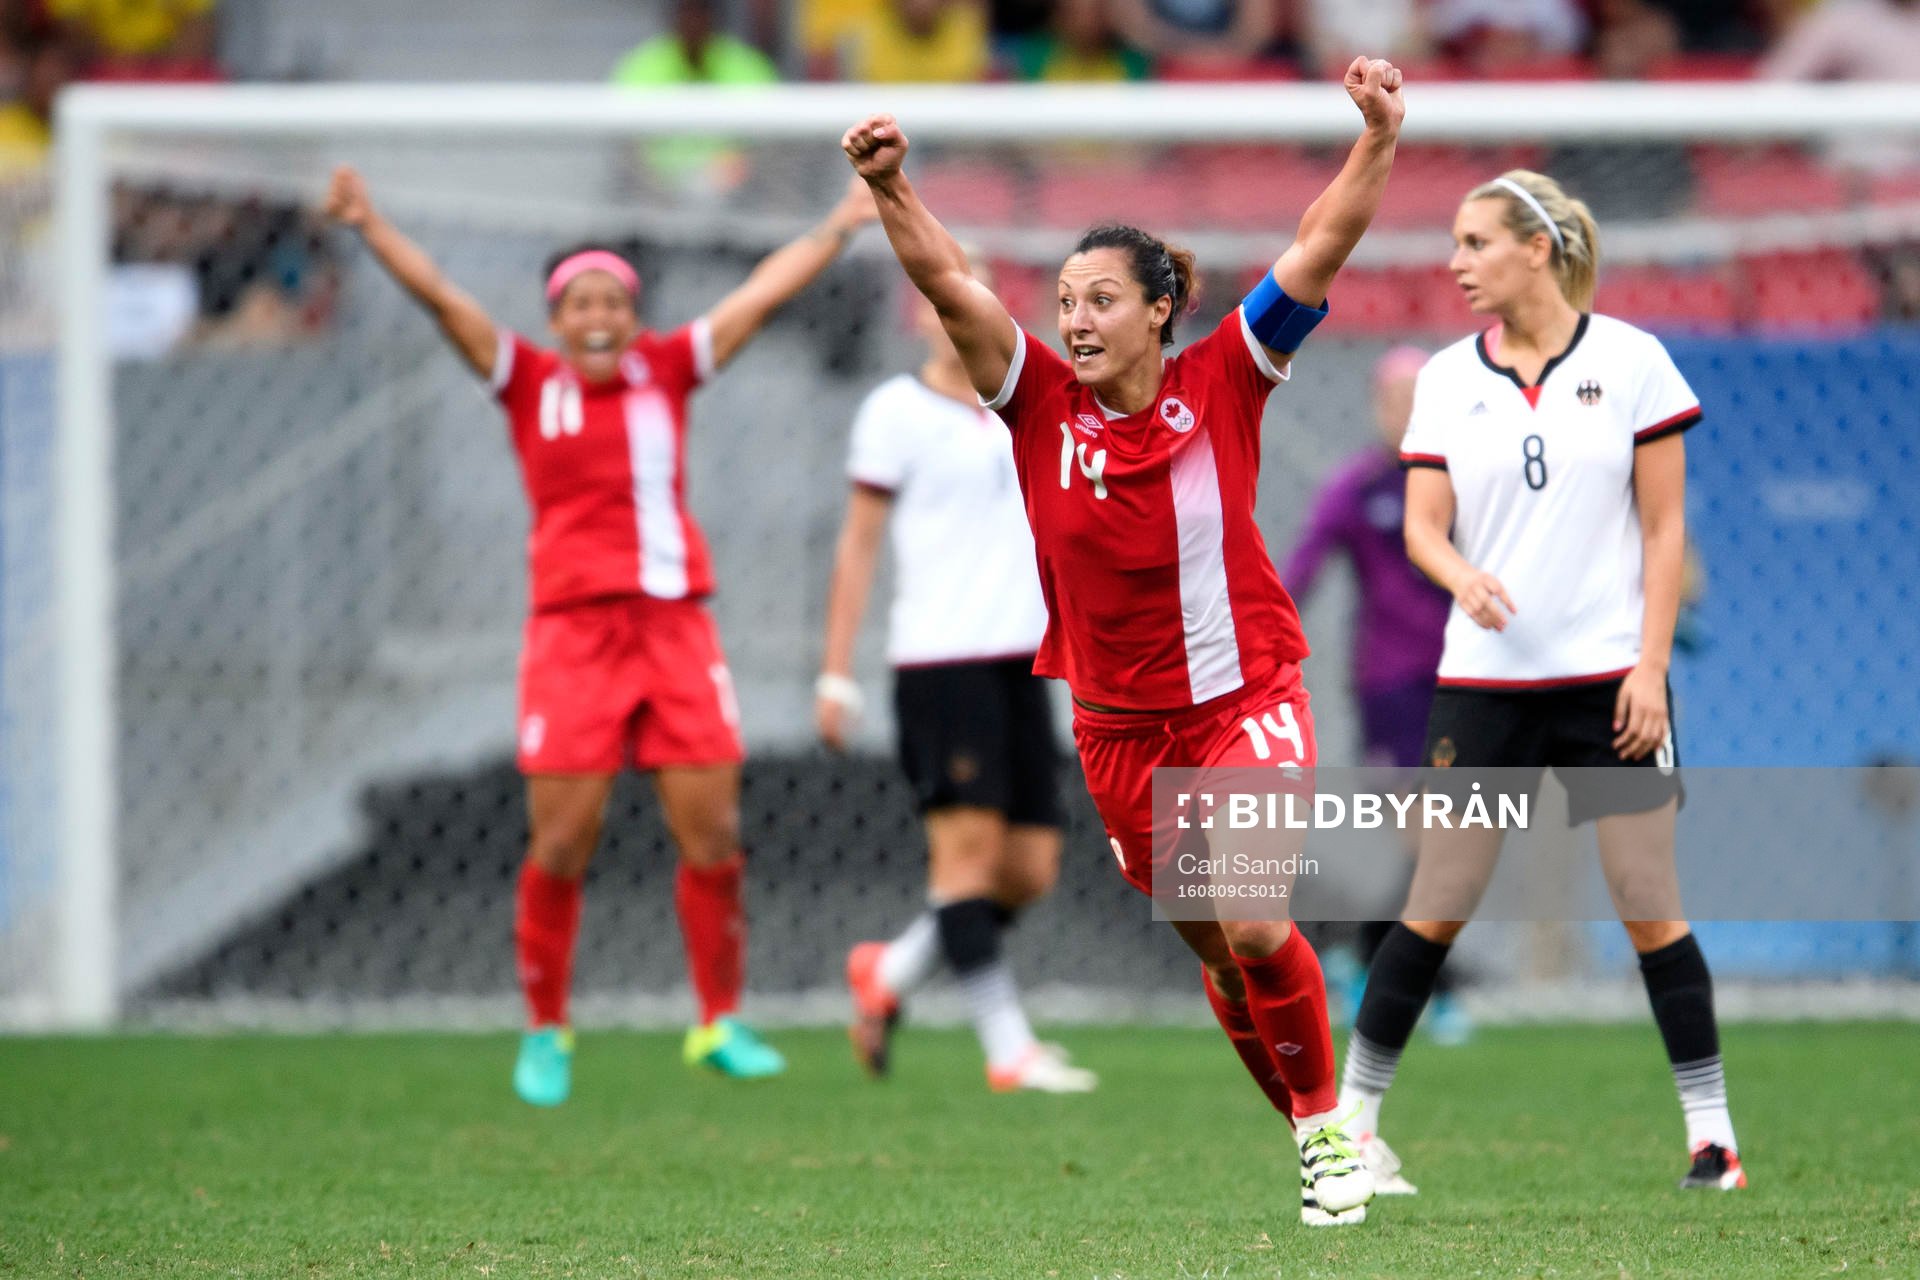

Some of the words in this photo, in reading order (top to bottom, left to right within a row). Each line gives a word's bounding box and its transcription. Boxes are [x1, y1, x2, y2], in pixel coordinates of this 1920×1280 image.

[1074, 422, 1098, 438] umbro
[1060, 421, 1108, 500] 14
[1523, 434, 1547, 490] 8
[1241, 702, 1304, 759] 14
